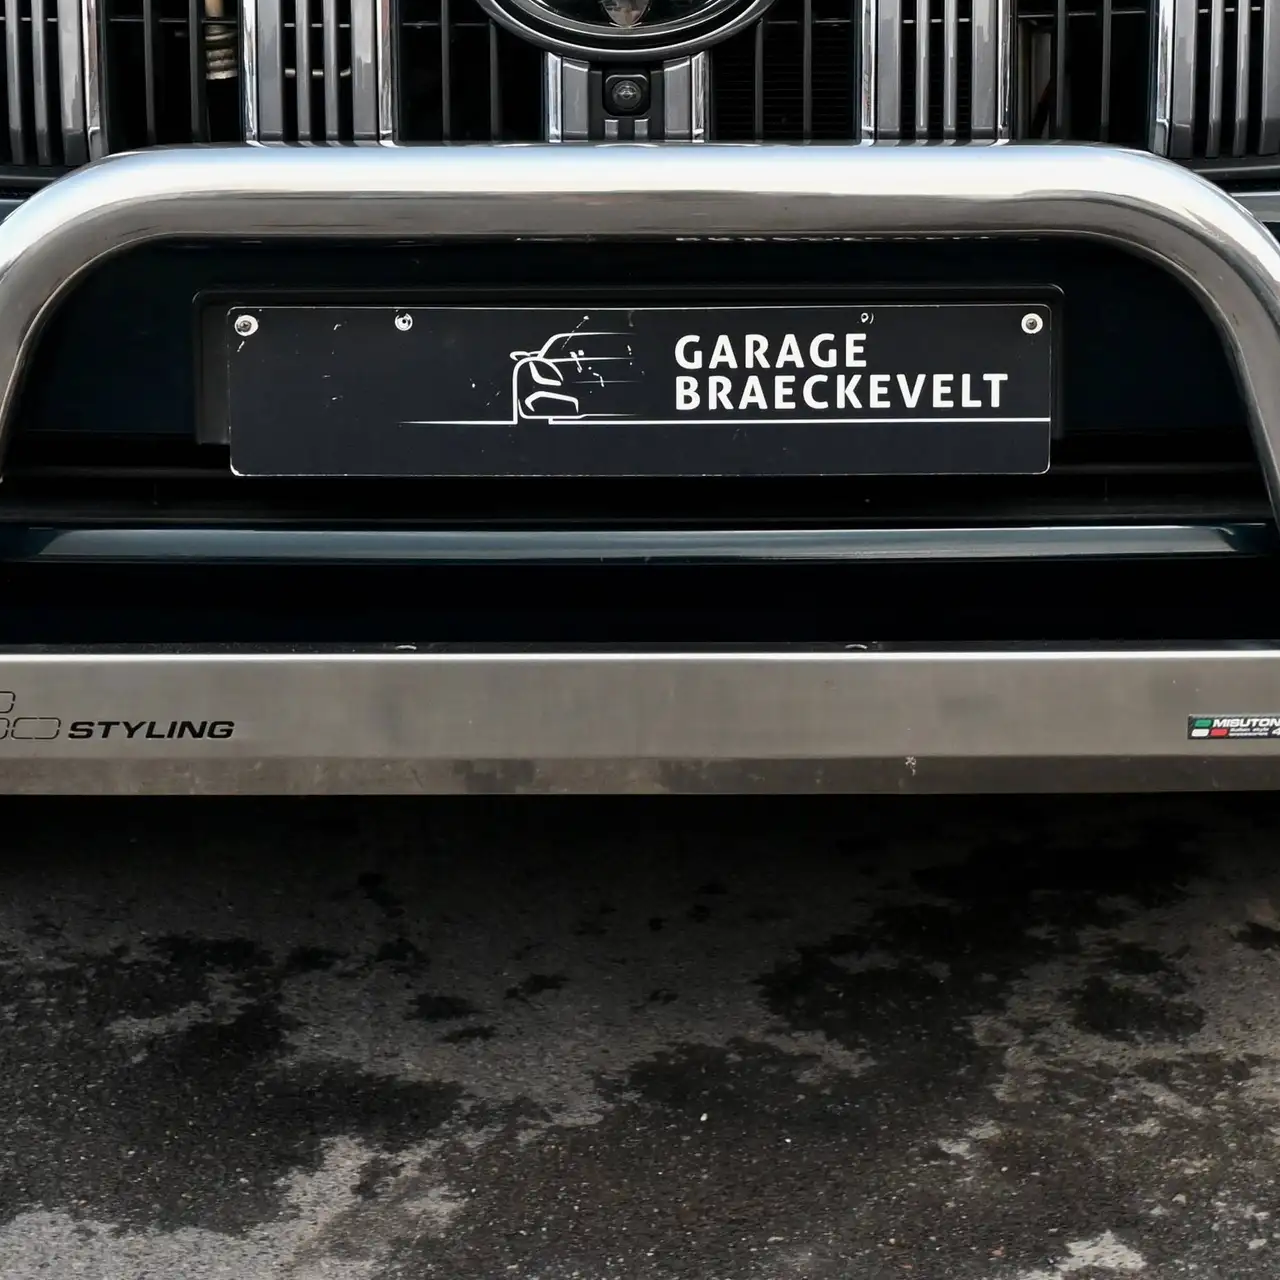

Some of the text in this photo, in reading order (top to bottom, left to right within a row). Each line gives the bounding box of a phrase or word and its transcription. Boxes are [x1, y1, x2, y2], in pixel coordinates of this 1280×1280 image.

[674, 332, 867, 370] GARAGE
[675, 373, 1009, 411] BRAECKEVELT
[68, 720, 235, 739] STYLING
